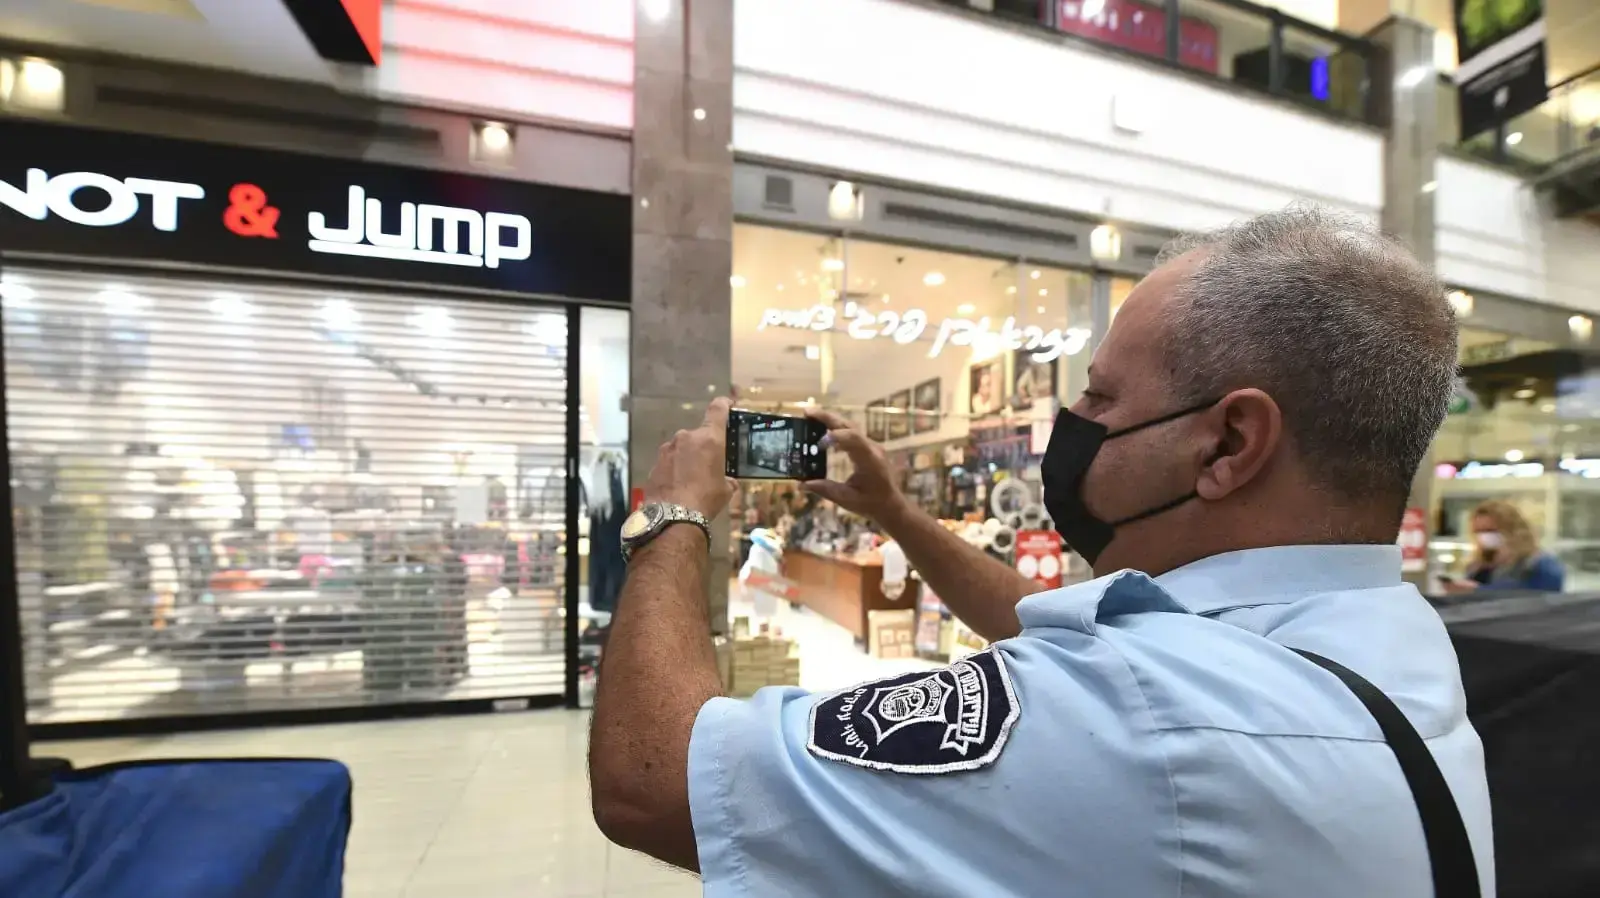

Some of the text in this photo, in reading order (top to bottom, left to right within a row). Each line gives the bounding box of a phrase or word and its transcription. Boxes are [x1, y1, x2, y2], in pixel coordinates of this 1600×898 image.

[223, 183, 279, 239] &
[308, 185, 531, 268] Jump
[836, 688, 869, 758] רישוי עסקים
